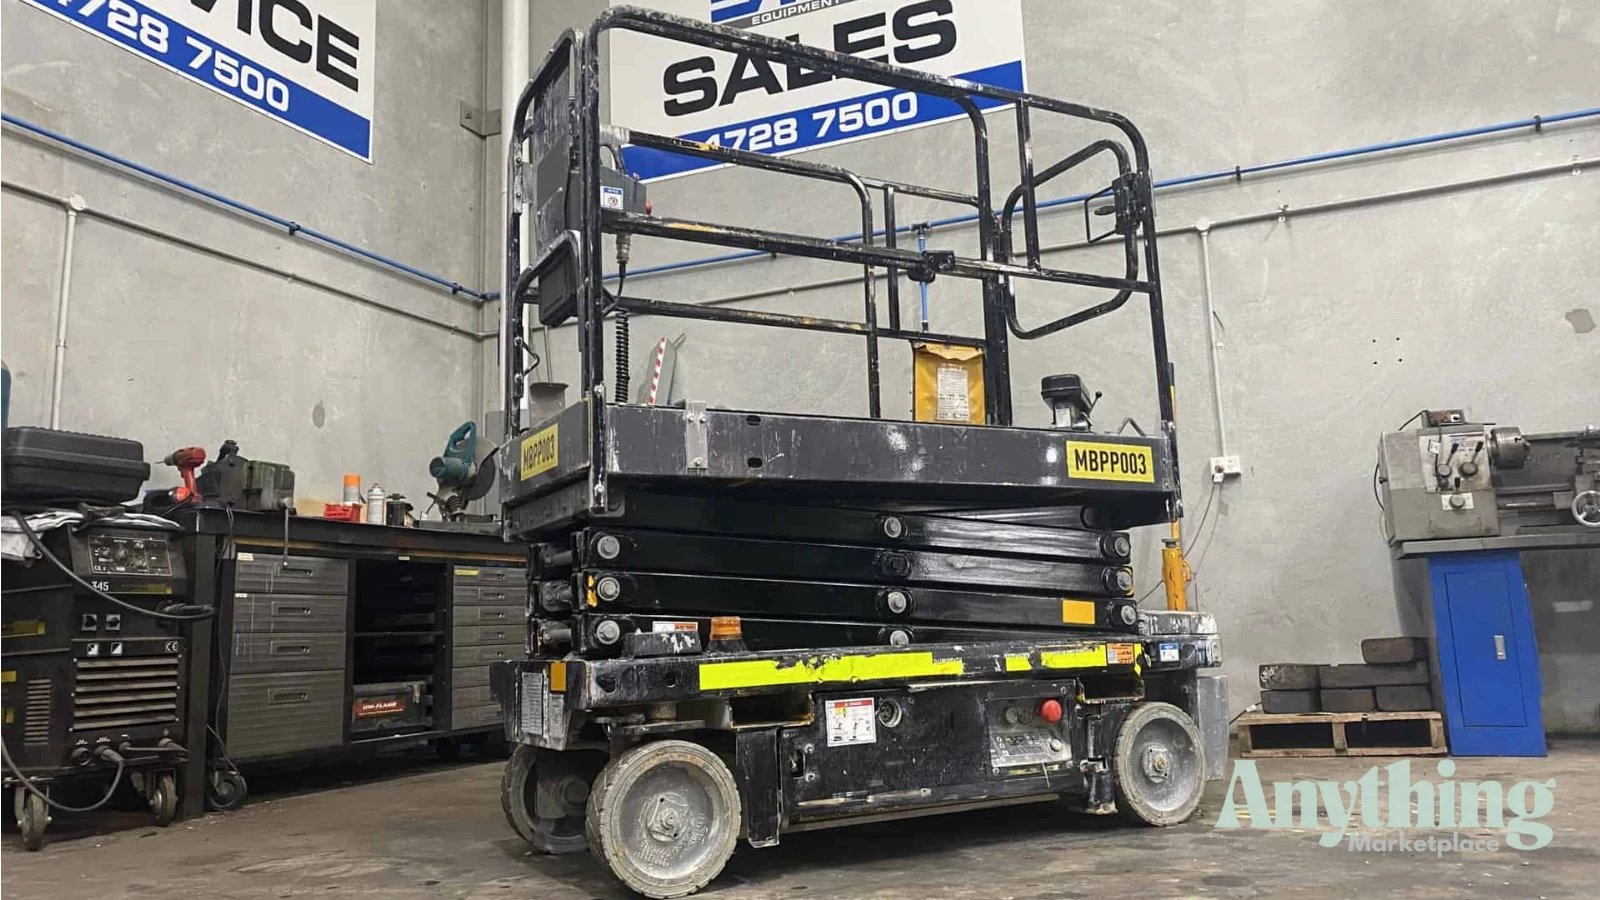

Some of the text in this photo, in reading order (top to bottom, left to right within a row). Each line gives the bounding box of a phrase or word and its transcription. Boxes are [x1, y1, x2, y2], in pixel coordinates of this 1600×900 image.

[57, 0, 289, 112] 728 7500
[189, 0, 360, 93] ICE
[663, 0, 958, 117] SALES
[812, 92, 918, 138] 7500
[523, 434, 555, 473] MBPP003
[1074, 448, 1147, 475] MBPP003
[91, 580, 109, 592] 345
